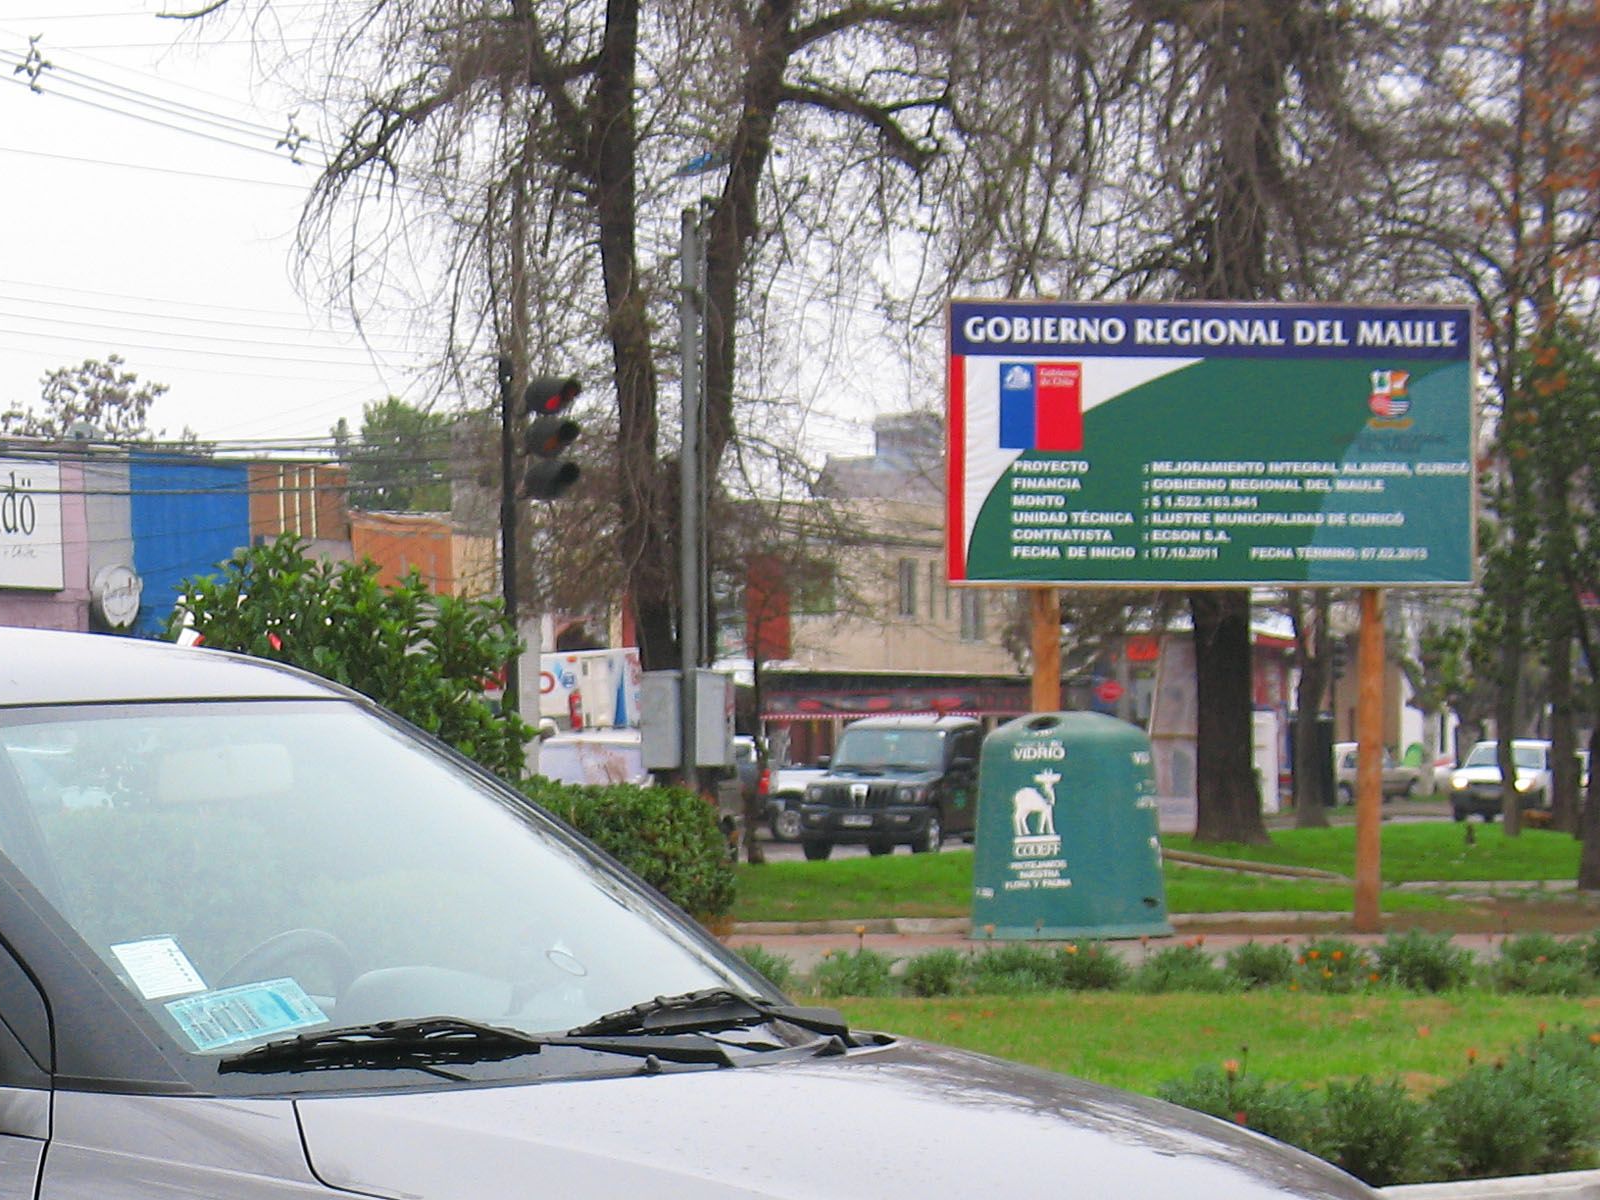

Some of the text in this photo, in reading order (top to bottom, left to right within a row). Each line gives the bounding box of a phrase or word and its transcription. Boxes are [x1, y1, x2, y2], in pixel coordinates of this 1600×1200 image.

[964, 316, 1459, 347] GOBIERNO REGIONAL DEL MAULE
[1012, 460, 1090, 473] PROYECTO
[1152, 461, 1266, 474] MEJORAMIENTO
[1268, 461, 1339, 475] INTEGRAL
[1012, 477, 1082, 490] FINANCIA
[1152, 478, 1227, 491] GOBIERNO
[1230, 478, 1302, 492] REGIONAL
[1304, 479, 1332, 492] DEL
[1335, 479, 1385, 492] MAULE
[1012, 494, 1067, 507] MONTO
[1012, 511, 1069, 524] UNIDAD
[1071, 509, 1135, 525] TÉCNICA
[1152, 512, 1212, 525] ILUSTRE
[1214, 512, 1325, 526] MUNICIPALIDAD
[1327, 513, 1348, 526] DE
[1012, 528, 1114, 542] CONTRATISTA
[1152, 529, 1201, 542] ECSON
[1012, 545, 1061, 558] FECHA
[1067, 546, 1088, 558] DE
[1091, 546, 1137, 558] INICIO
[1250, 547, 1295, 561] FECHA
[1013, 746, 1066, 761] VIDRIO
